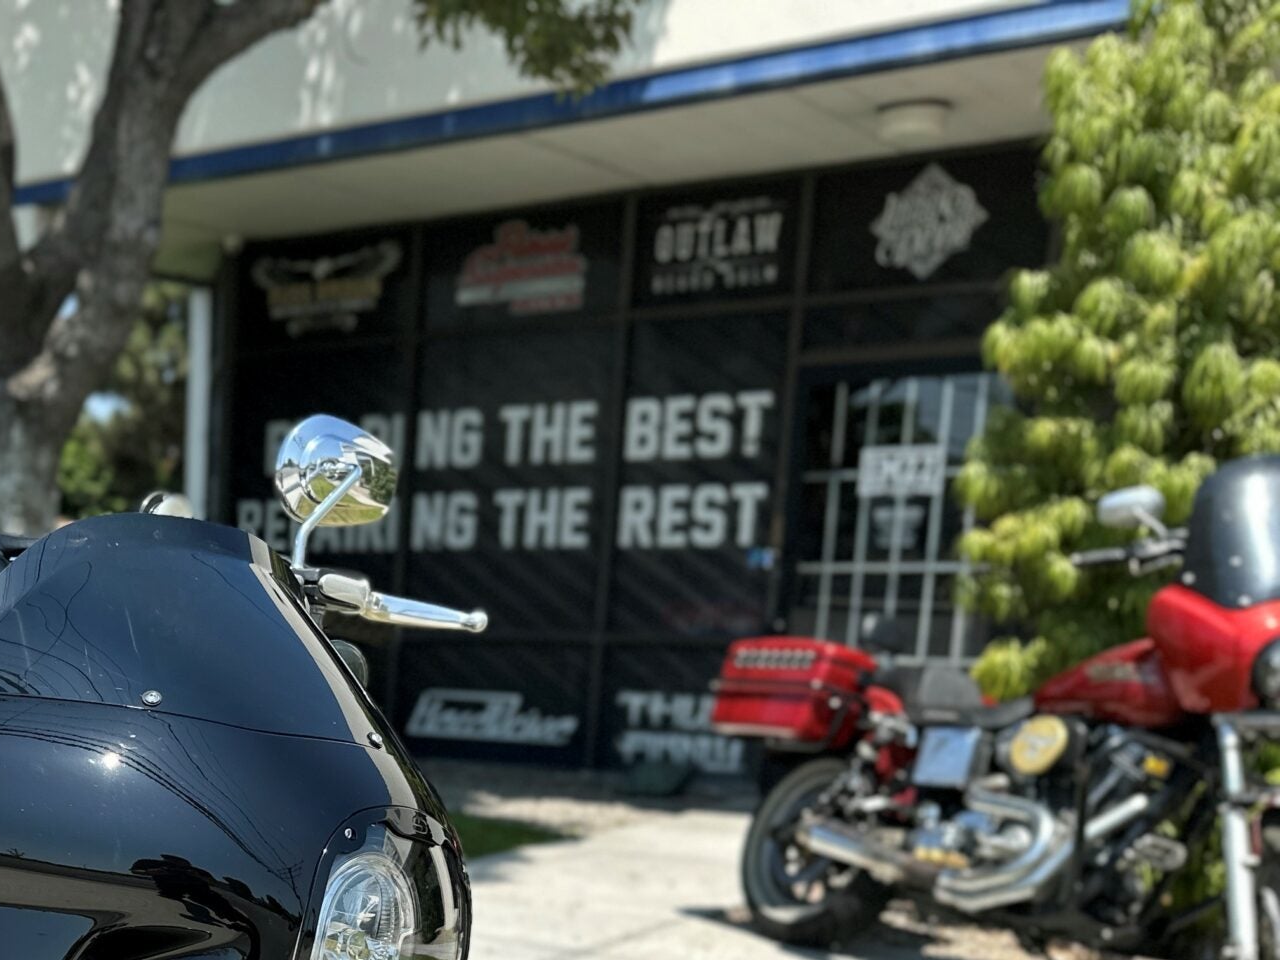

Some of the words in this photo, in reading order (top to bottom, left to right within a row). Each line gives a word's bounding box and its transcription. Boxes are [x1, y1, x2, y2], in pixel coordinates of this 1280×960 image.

[500, 401, 599, 464] THE
[624, 389, 776, 460] BEST
[236, 489, 480, 553] REAIRING
[494, 486, 594, 548] THE
[618, 481, 770, 546] REST
